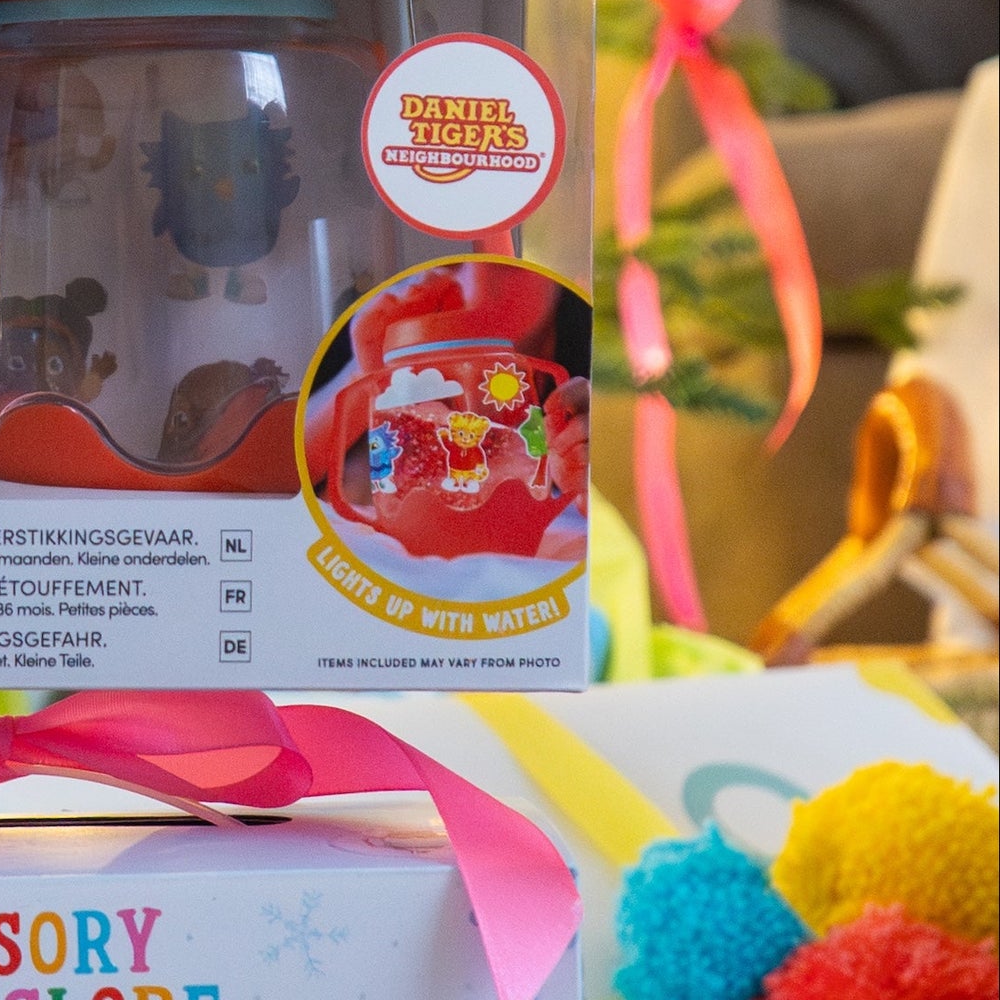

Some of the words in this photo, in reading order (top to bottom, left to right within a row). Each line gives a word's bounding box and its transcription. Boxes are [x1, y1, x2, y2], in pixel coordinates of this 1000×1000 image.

[401, 94, 514, 124] DANIEL
[411, 122, 527, 152] TIGER'S
[225, 539, 247, 554] NL
[77, 552, 120, 566] Kleine
[123, 552, 211, 567] onderdelen.
[225, 590, 246, 604] FR
[315, 546, 382, 605] LIGHTS
[385, 595, 415, 621] UP
[421, 606, 474, 633] WITH
[483, 596, 561, 633] WATER!
[17, 603, 55, 617] mois.
[59, 603, 106, 617] Petites
[108, 602, 159, 619] pièces.
[224, 640, 247, 654] DE
[14, 653, 57, 668] Kleine
[59, 653, 95, 668] Teile.
[318, 657, 354, 668] ITEMS
[357, 657, 417, 668] INCLUDED
[421, 657, 446, 668] MAY
[448, 657, 477, 668] VARY
[481, 657, 516, 668] FROM
[519, 657, 561, 668] PHOTO
